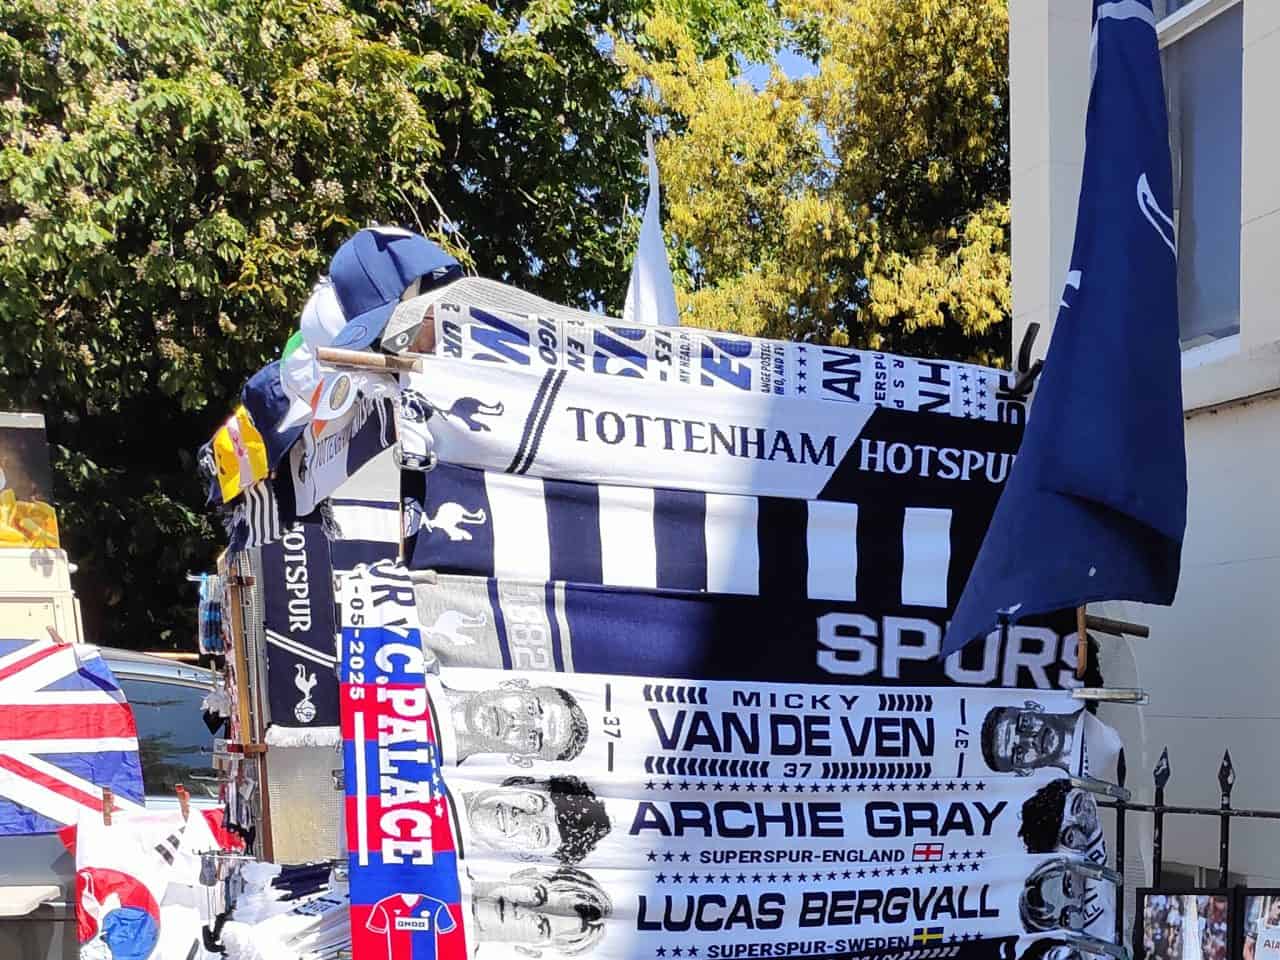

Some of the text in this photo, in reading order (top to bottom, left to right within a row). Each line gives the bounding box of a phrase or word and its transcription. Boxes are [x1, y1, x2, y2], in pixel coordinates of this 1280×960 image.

[565, 406, 1017, 483] TOTTENHAM HOTSPU
[348, 571, 366, 700] 1-05-2025
[732, 690, 860, 711] MICKY
[649, 709, 935, 757] VAN DE VEN
[784, 761, 812, 778] 37
[629, 798, 1008, 838] ARCHIE GRAY
[699, 847, 905, 866] SUPERSPUR-ENGLAND
[636, 885, 1000, 932] LUCAS BERGVALL
[706, 935, 912, 959] SUPERSPUR-SWEDEN
